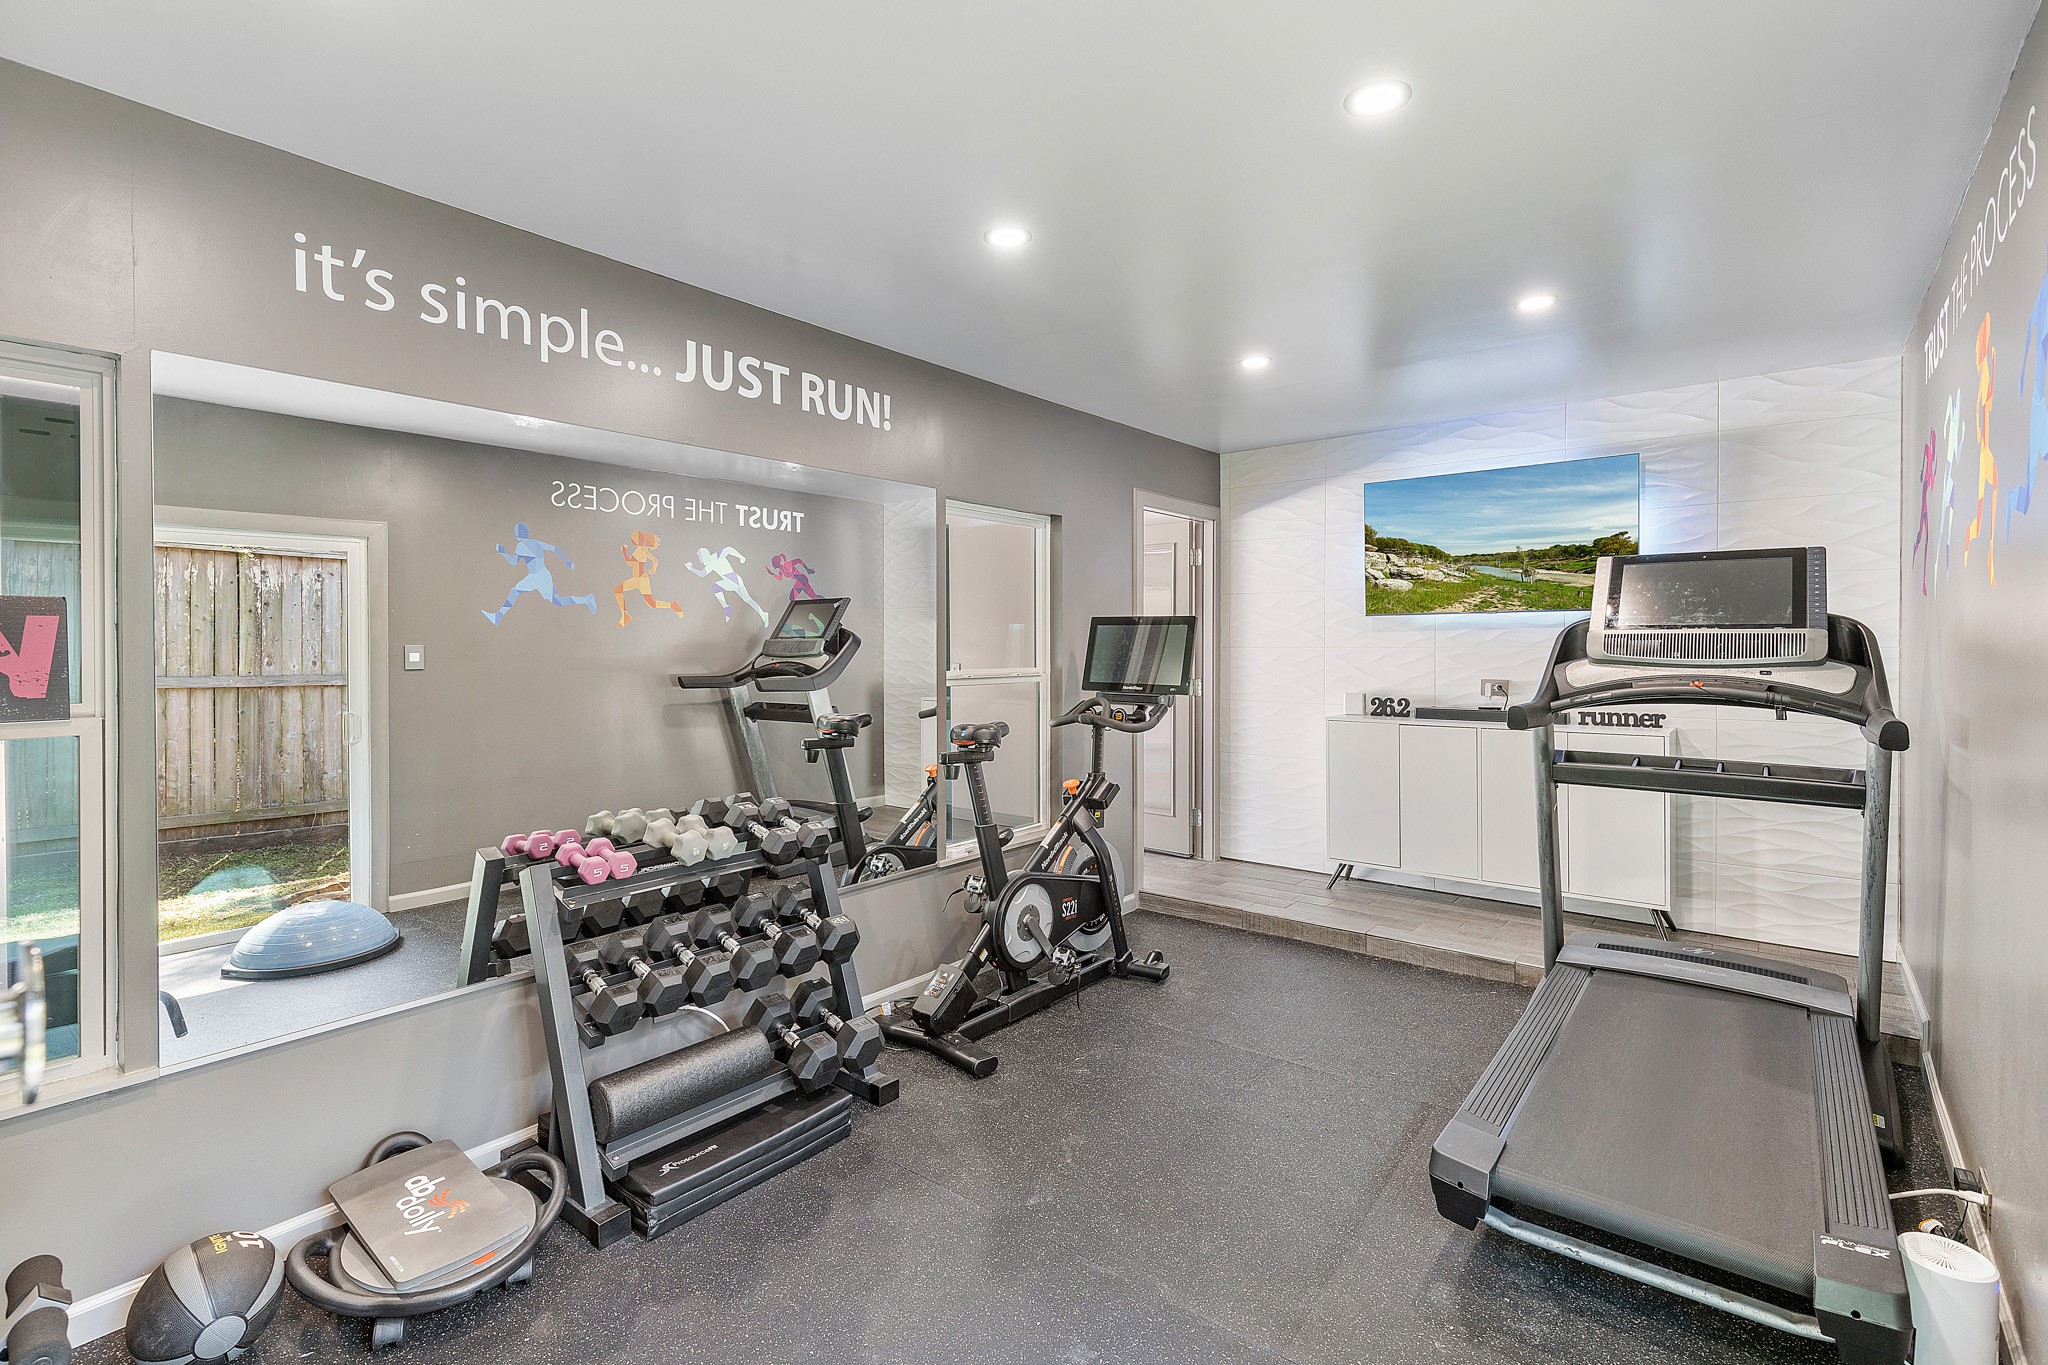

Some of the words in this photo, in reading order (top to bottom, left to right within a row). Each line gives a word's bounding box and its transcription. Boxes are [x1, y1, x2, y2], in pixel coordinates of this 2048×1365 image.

[1924, 296, 1950, 385] TRUST
[1951, 252, 1968, 336] THE
[1970, 105, 2036, 298] PROCESS
[419, 276, 662, 377] simple...
[675, 339, 790, 406] JUST
[801, 371, 891, 432] RUN!
[1578, 710, 1667, 728] runner
[593, 868, 603, 878] 5
[619, 864, 629, 873] 5
[404, 1175, 446, 1197] ab
[396, 1196, 446, 1235] dolly
[232, 1231, 264, 1249] 10
